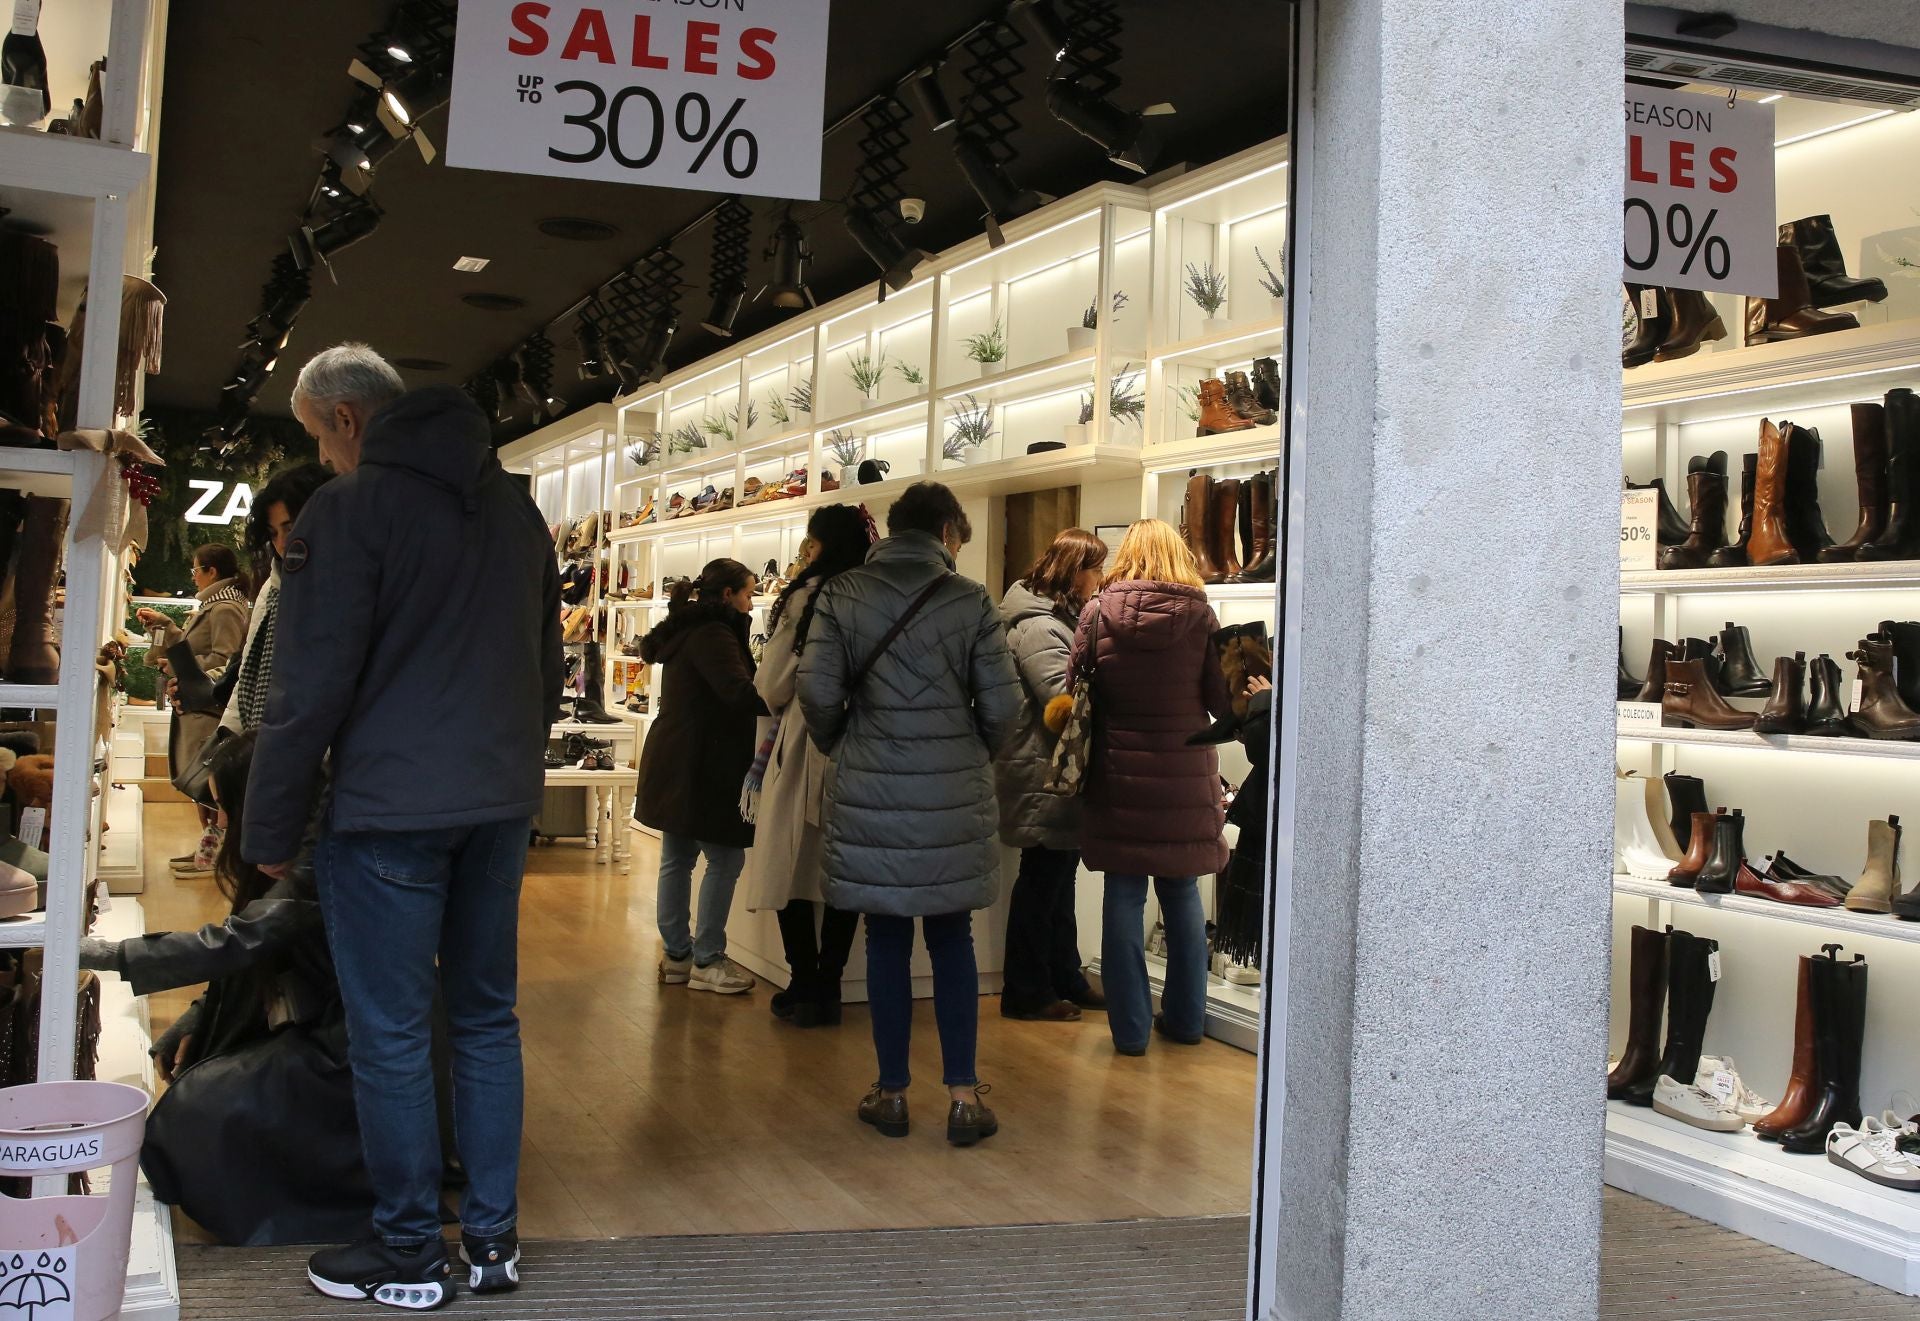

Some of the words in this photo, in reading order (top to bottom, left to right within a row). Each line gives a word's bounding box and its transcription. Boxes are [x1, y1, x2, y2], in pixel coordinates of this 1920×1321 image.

[508, 2, 777, 80] SALES
[516, 89, 543, 104] TO
[517, 74, 544, 89] UP
[548, 80, 759, 179] 30%
[1630, 134, 1738, 194] LES
[1624, 197, 1731, 280] 0%
[0, 1139, 99, 1162] ARAGUAS
